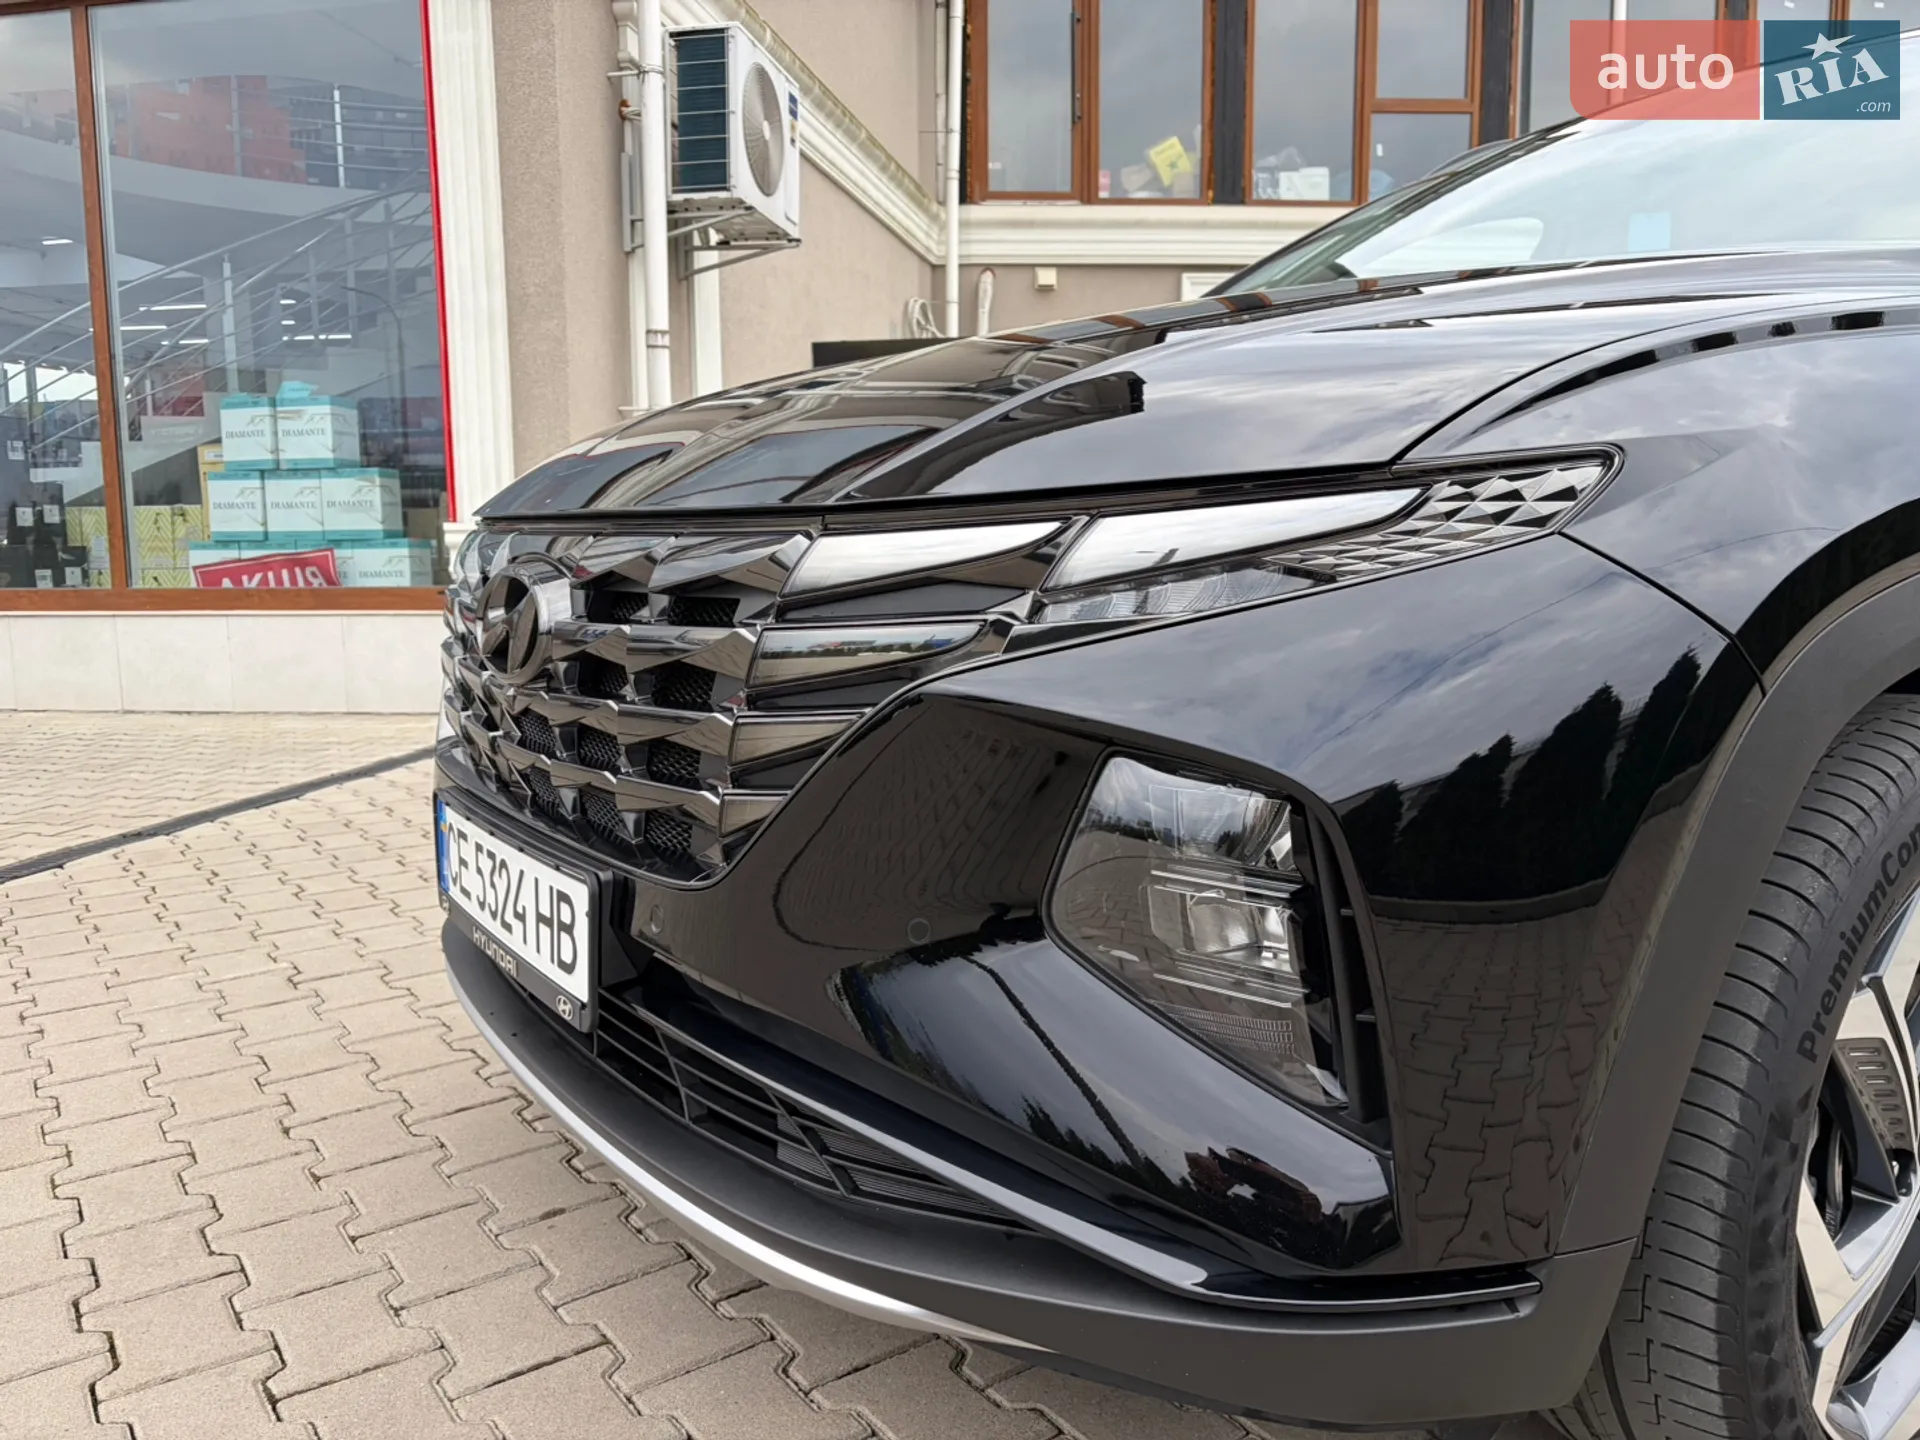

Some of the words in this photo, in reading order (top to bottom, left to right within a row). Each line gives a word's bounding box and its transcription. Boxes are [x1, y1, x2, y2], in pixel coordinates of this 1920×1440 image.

[225, 429, 266, 439] DIAMANTE
[281, 428, 326, 437] DIAMANTE
[213, 501, 257, 510] DIAMANTE
[270, 501, 317, 510] DIAMANTE
[326, 500, 375, 509] DIAMANTE
[358, 570, 406, 579] DIAMANTE
[449, 821, 472, 901] CE
[475, 840, 527, 946] 5324
[534, 876, 578, 976] HB
[472, 926, 519, 978] HYUNDAI
